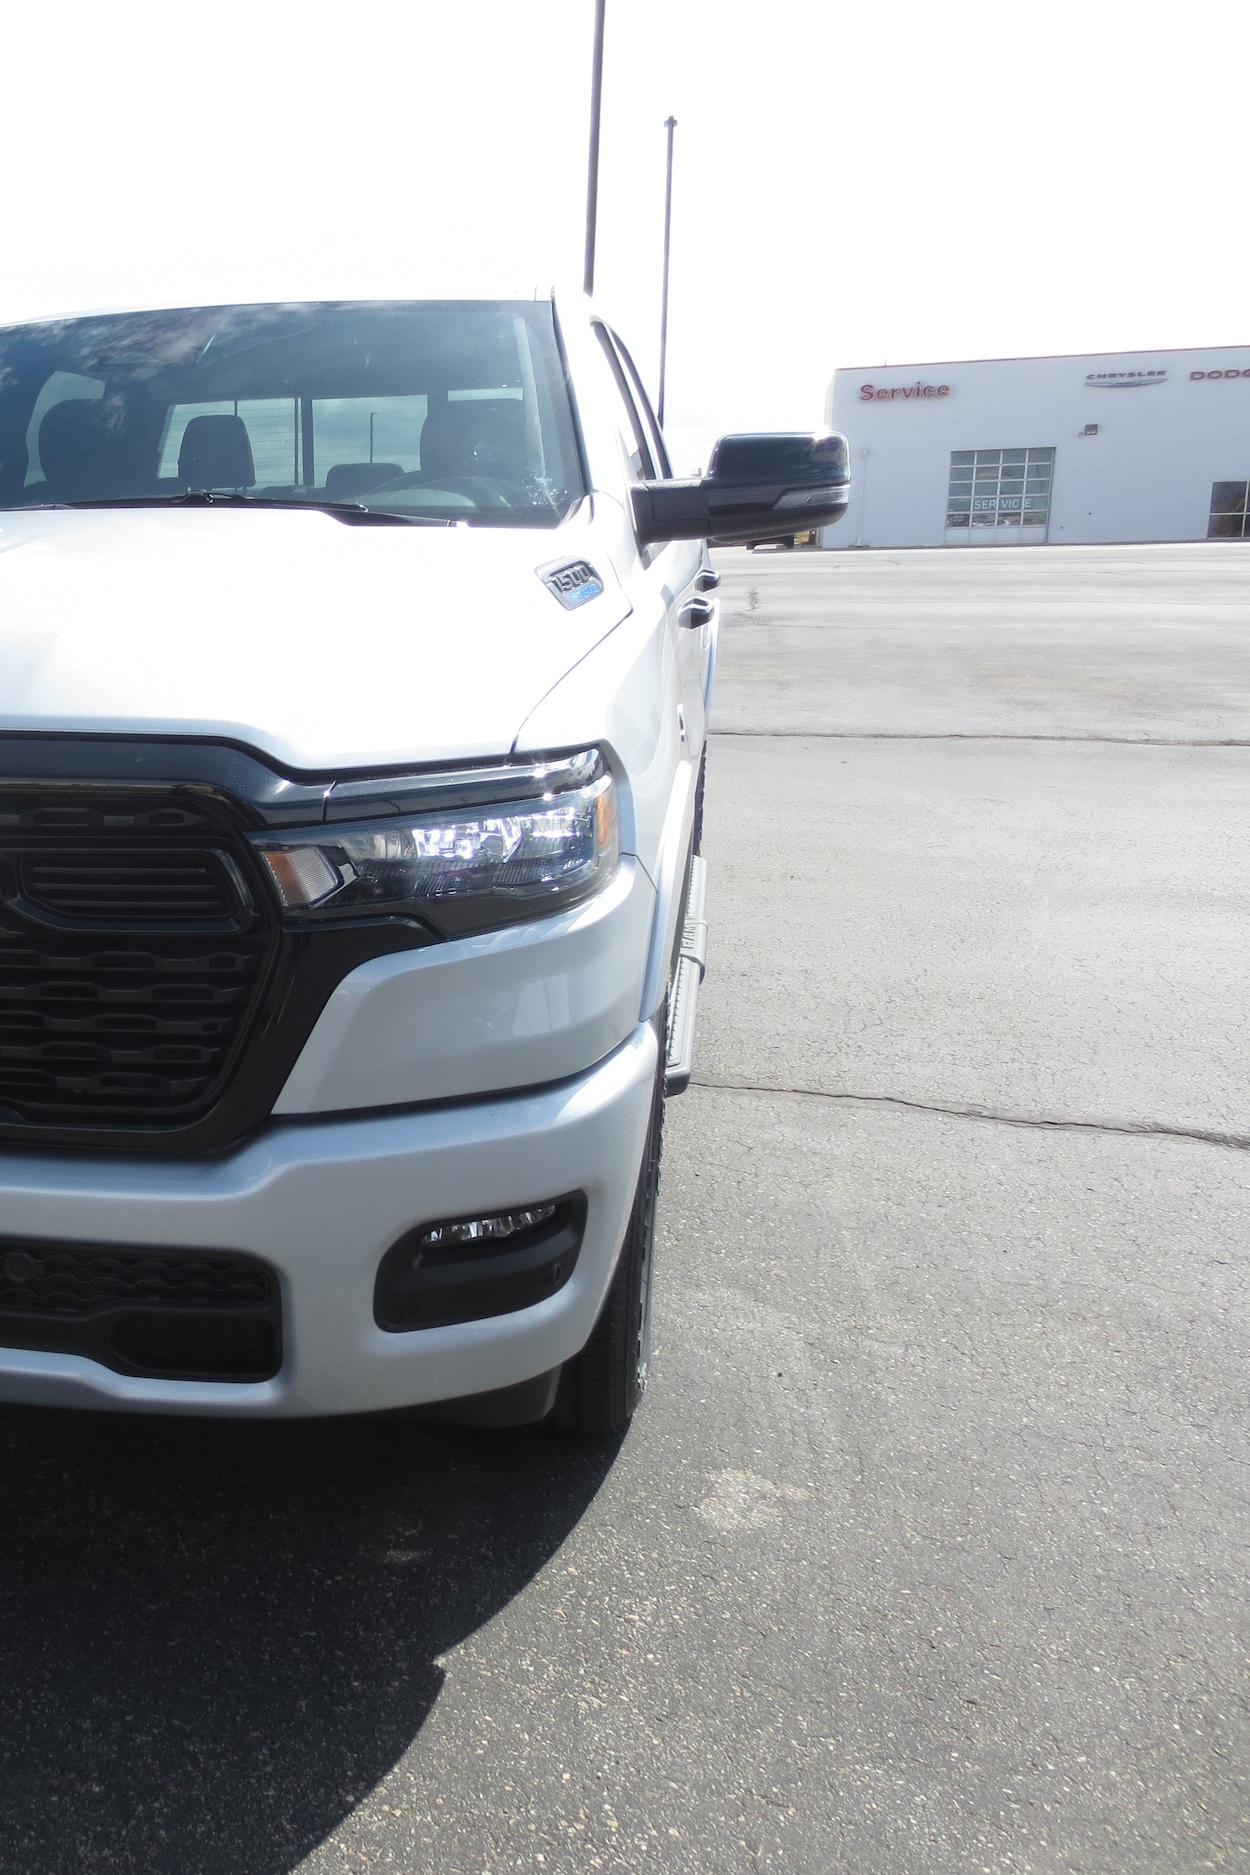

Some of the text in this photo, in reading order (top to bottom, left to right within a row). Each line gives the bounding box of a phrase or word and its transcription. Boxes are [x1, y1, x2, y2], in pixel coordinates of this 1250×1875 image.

[860, 381, 950, 401] Service
[973, 498, 1032, 510] SERVICE
[549, 564, 592, 594] 1500
